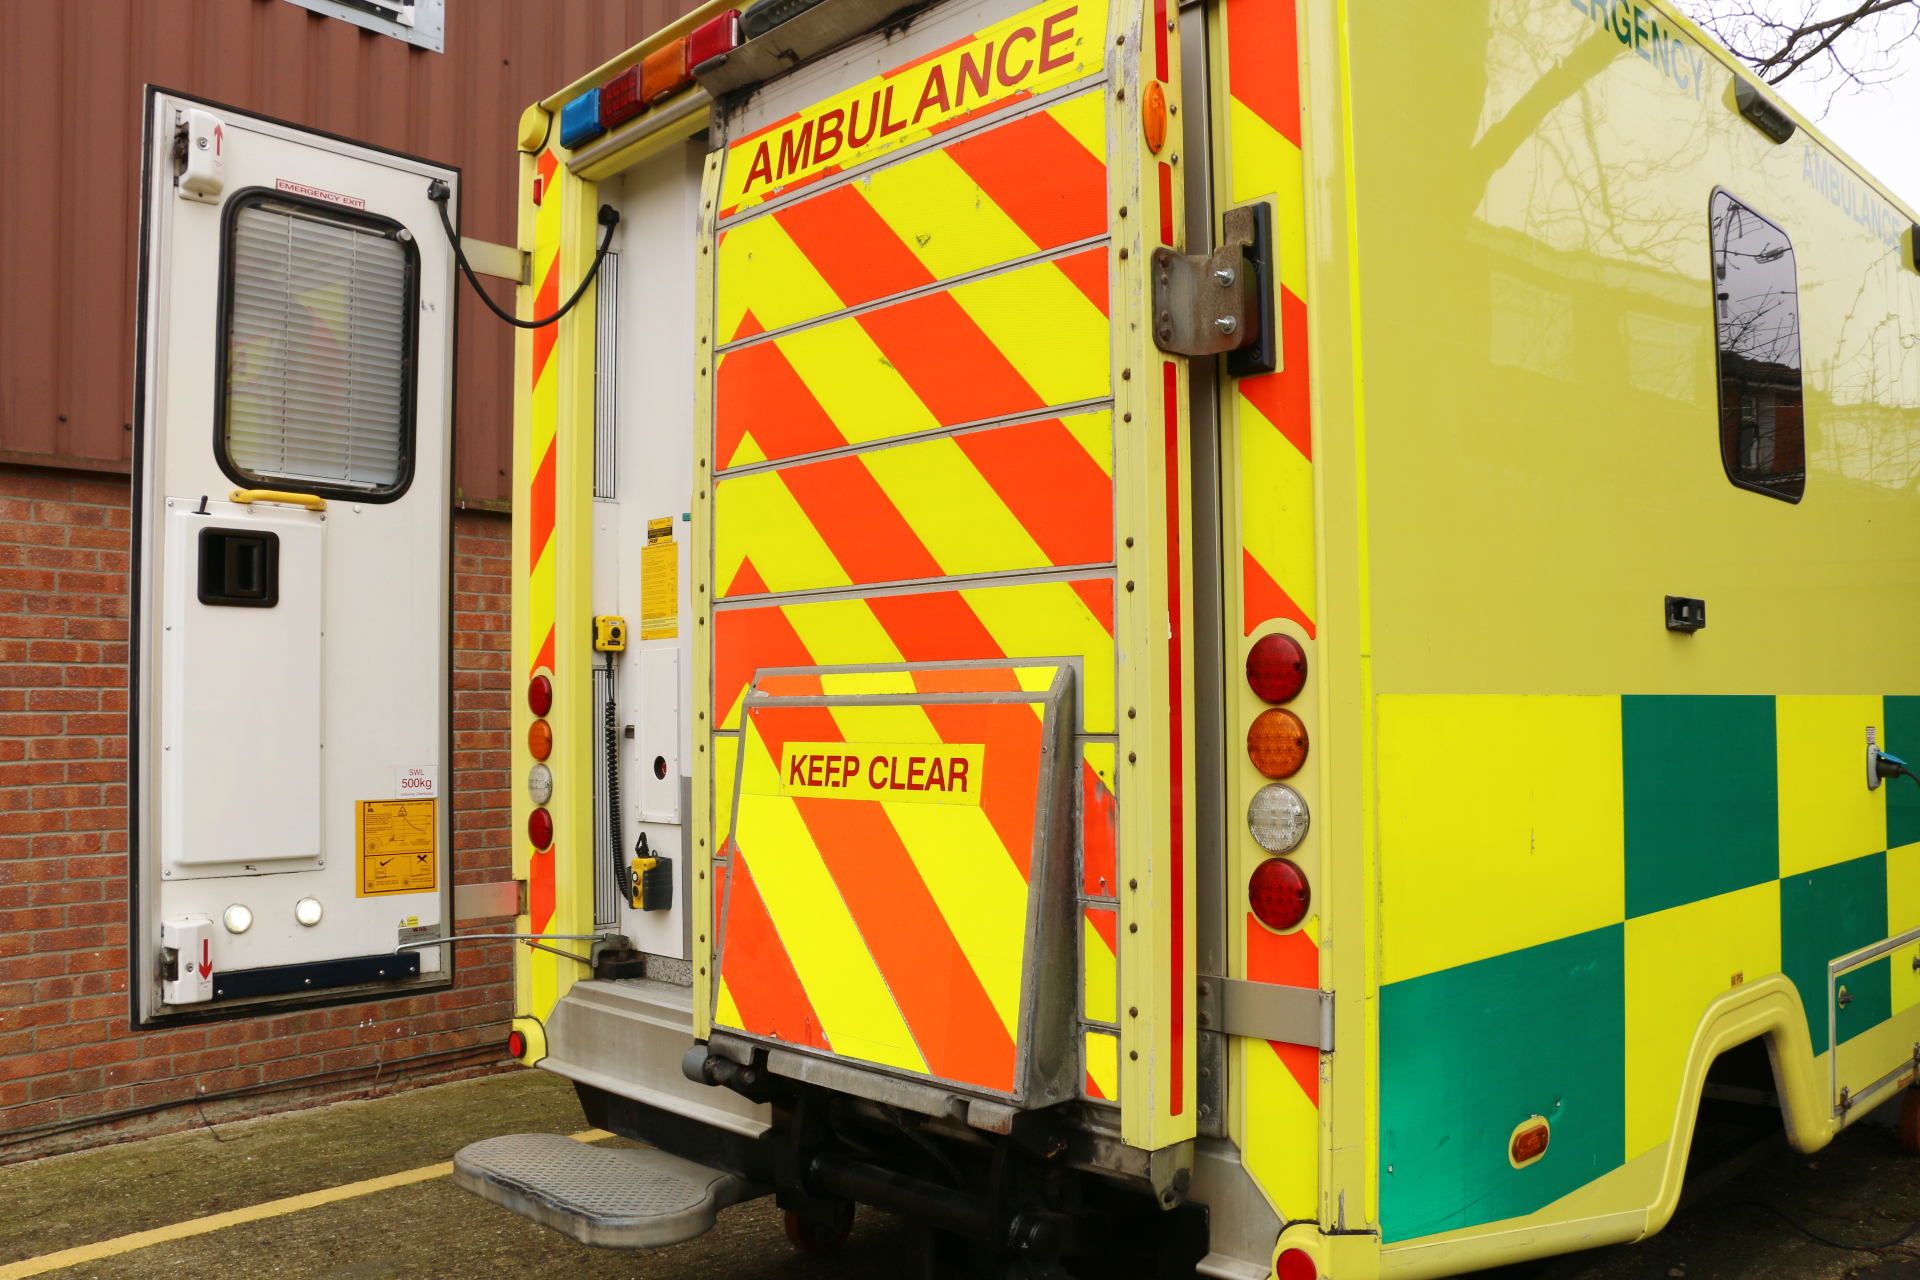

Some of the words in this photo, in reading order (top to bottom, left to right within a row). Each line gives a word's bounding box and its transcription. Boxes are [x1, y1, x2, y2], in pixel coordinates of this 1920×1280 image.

[1570, 0, 1704, 101] RGENCY
[742, 5, 1079, 194] AMBULANCE
[278, 181, 340, 202] EMERGENCY
[342, 197, 363, 207] EXIT
[1803, 144, 1902, 255] AMBULANCE
[401, 778, 432, 790] 500kg
[409, 768, 425, 776] SWL
[790, 755, 860, 788] KEEP
[868, 755, 969, 792] CLEAR
